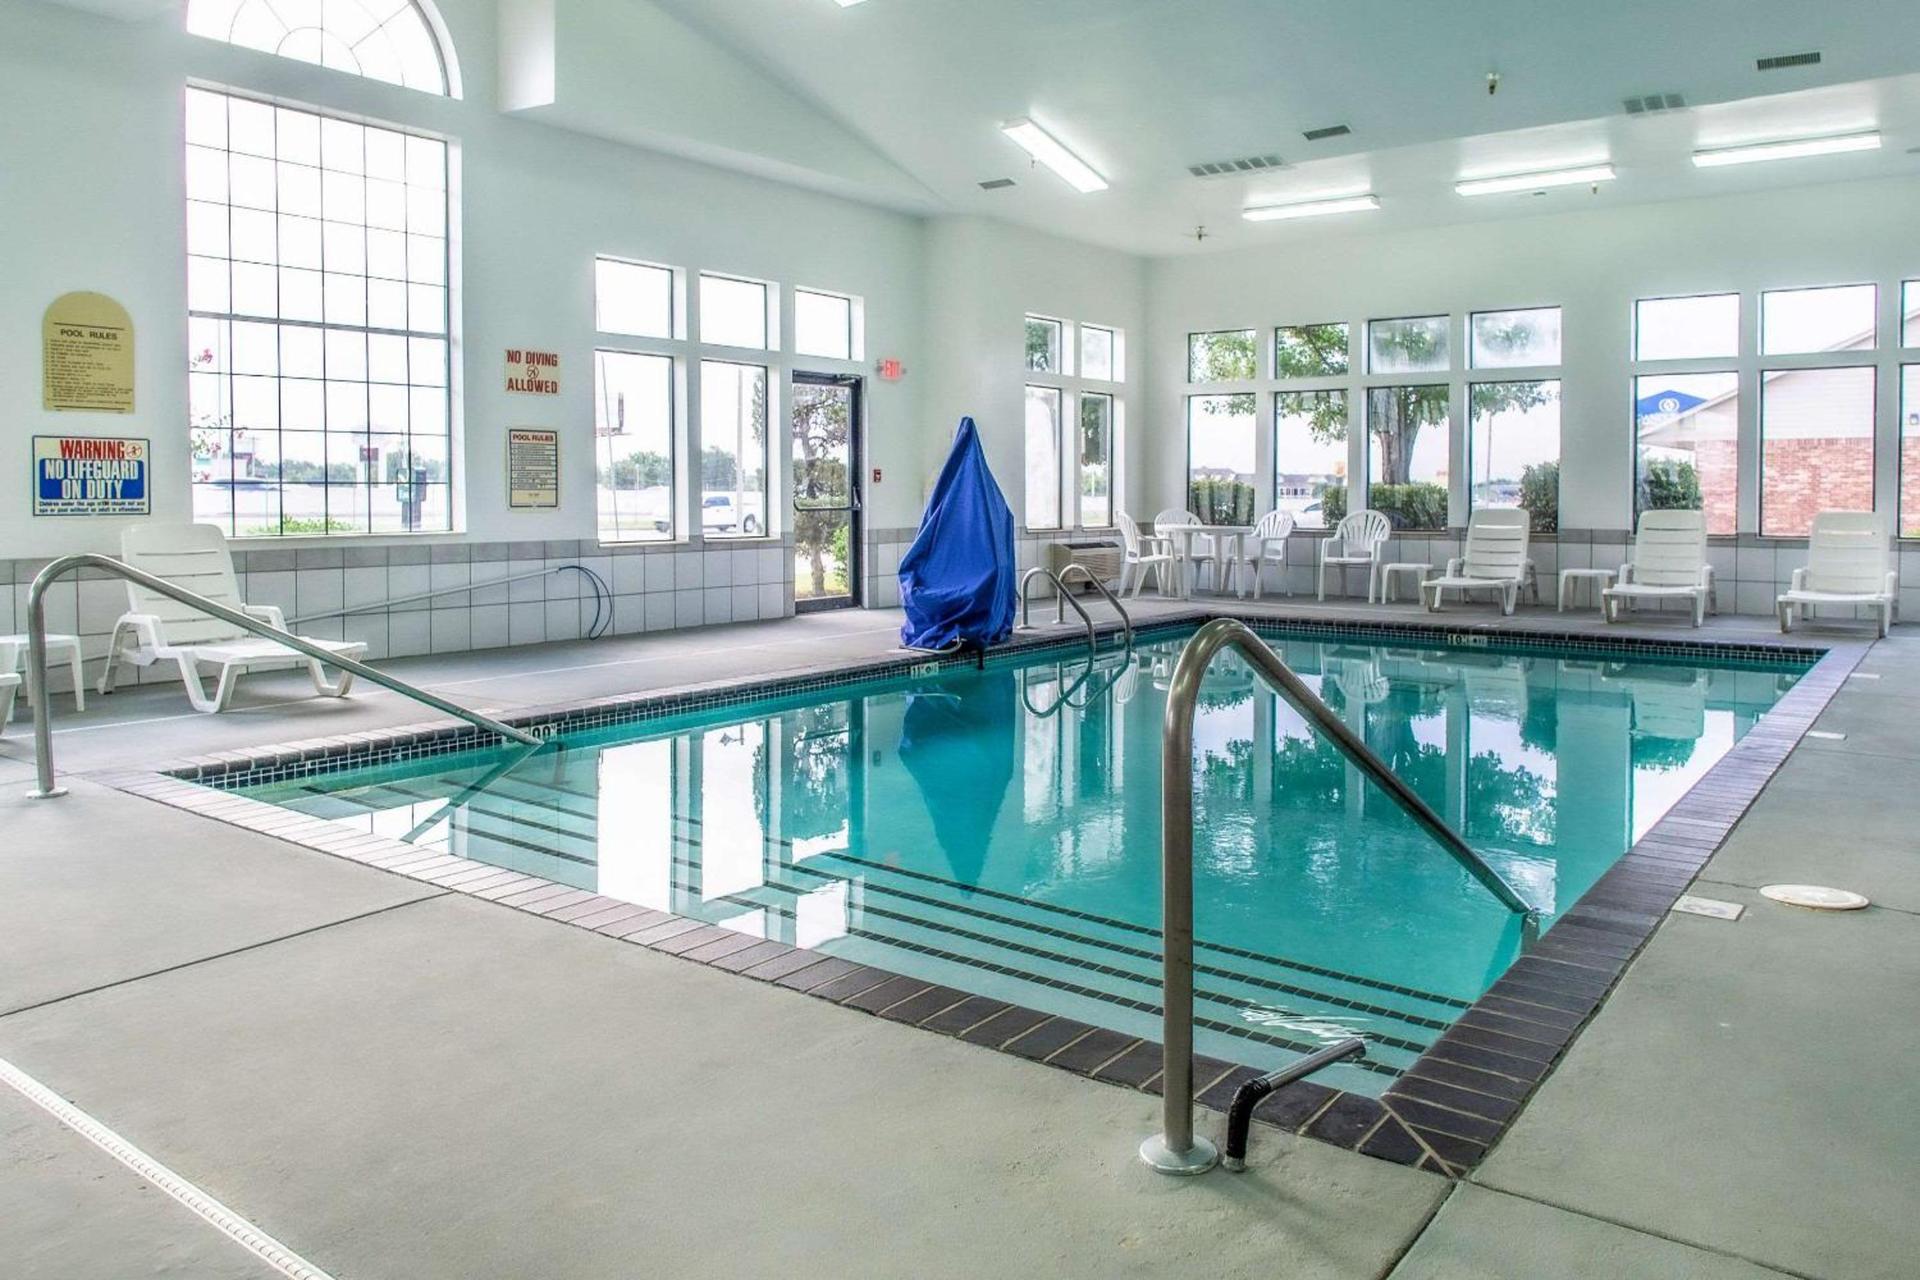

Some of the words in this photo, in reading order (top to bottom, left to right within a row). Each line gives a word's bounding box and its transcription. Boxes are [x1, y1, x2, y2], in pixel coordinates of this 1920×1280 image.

[60, 329, 84, 338] POOL
[89, 331, 118, 340] RULES
[507, 350, 521, 363] NO
[526, 351, 558, 366] DIVING
[507, 377, 558, 394] ALLOWED
[532, 434, 554, 442] RULES
[60, 440, 125, 459] WARNING
[45, 459, 65, 480] NO
[67, 460, 139, 480] LIFEGUARD
[61, 480, 82, 499] ON
[86, 480, 123, 499] DUTY
